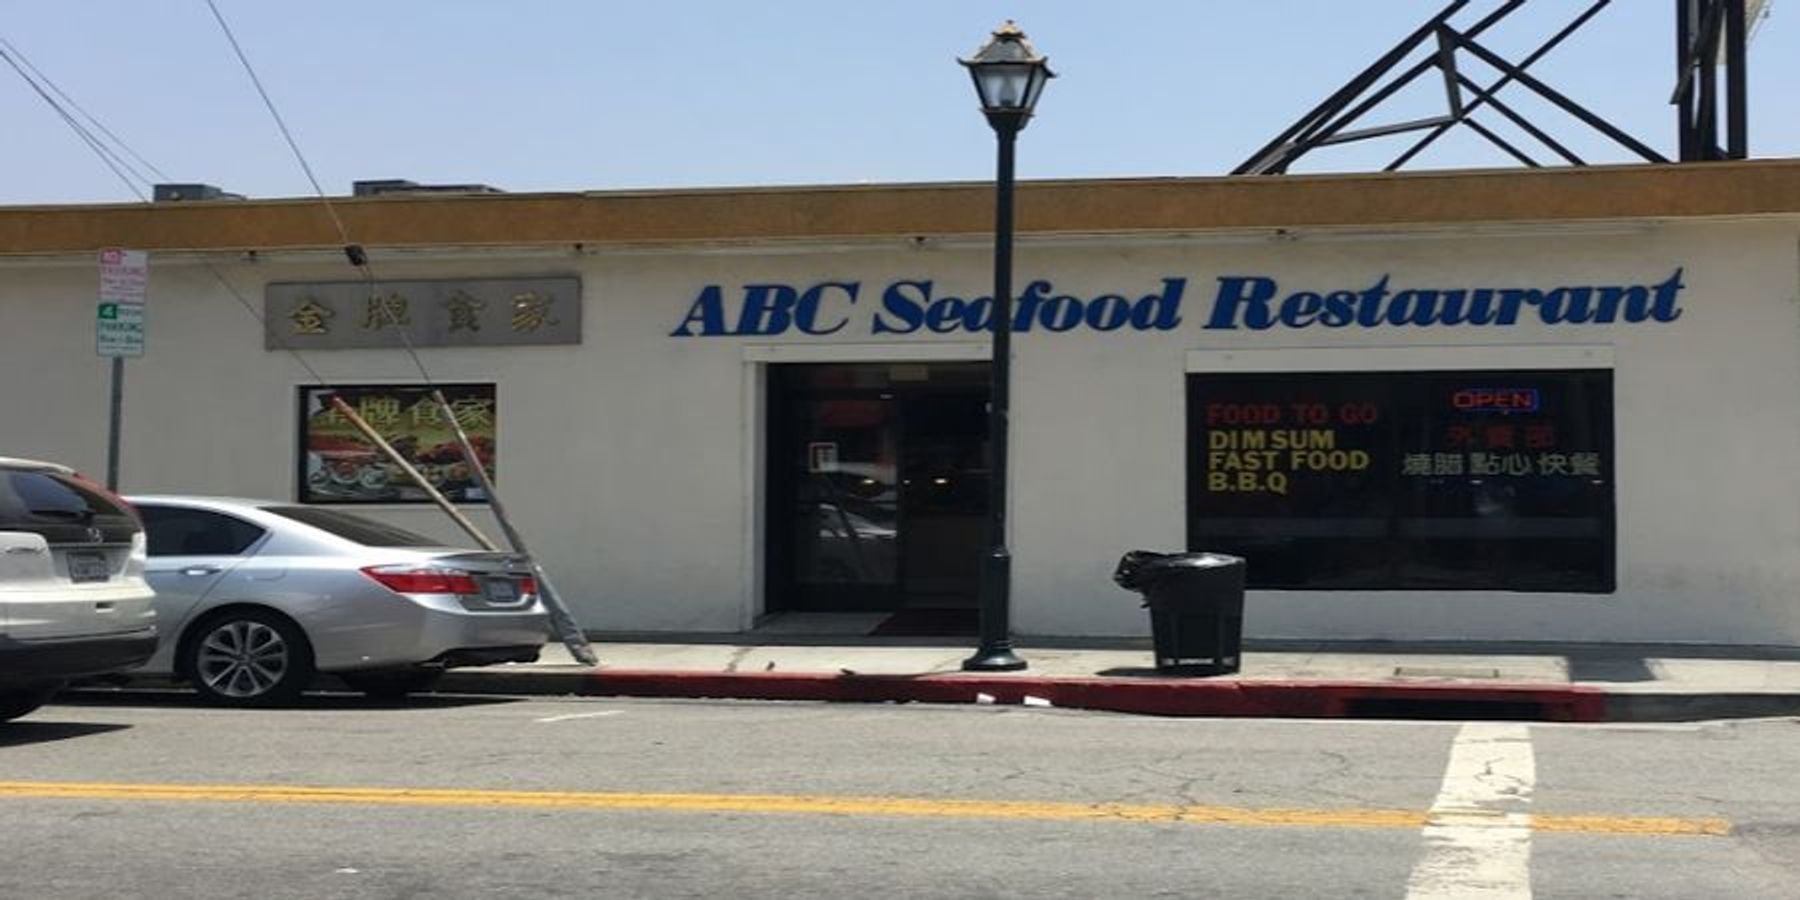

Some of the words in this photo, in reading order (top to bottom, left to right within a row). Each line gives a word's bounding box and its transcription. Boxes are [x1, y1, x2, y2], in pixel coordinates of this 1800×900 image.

[669, 281, 860, 337] ABC
[871, 277, 1186, 334] Seafood
[1203, 266, 1685, 330] Restaurant
[1454, 391, 1533, 409] OPEN
[1206, 403, 1282, 425] FOOD
[1292, 403, 1330, 424] TO
[1340, 402, 1377, 424] GO
[1208, 430, 1265, 450] DIM
[1270, 430, 1336, 450] SUM
[1209, 451, 1281, 471] FAST
[1290, 450, 1371, 471] FOOD
[1208, 472, 1289, 494] B.B.Q
